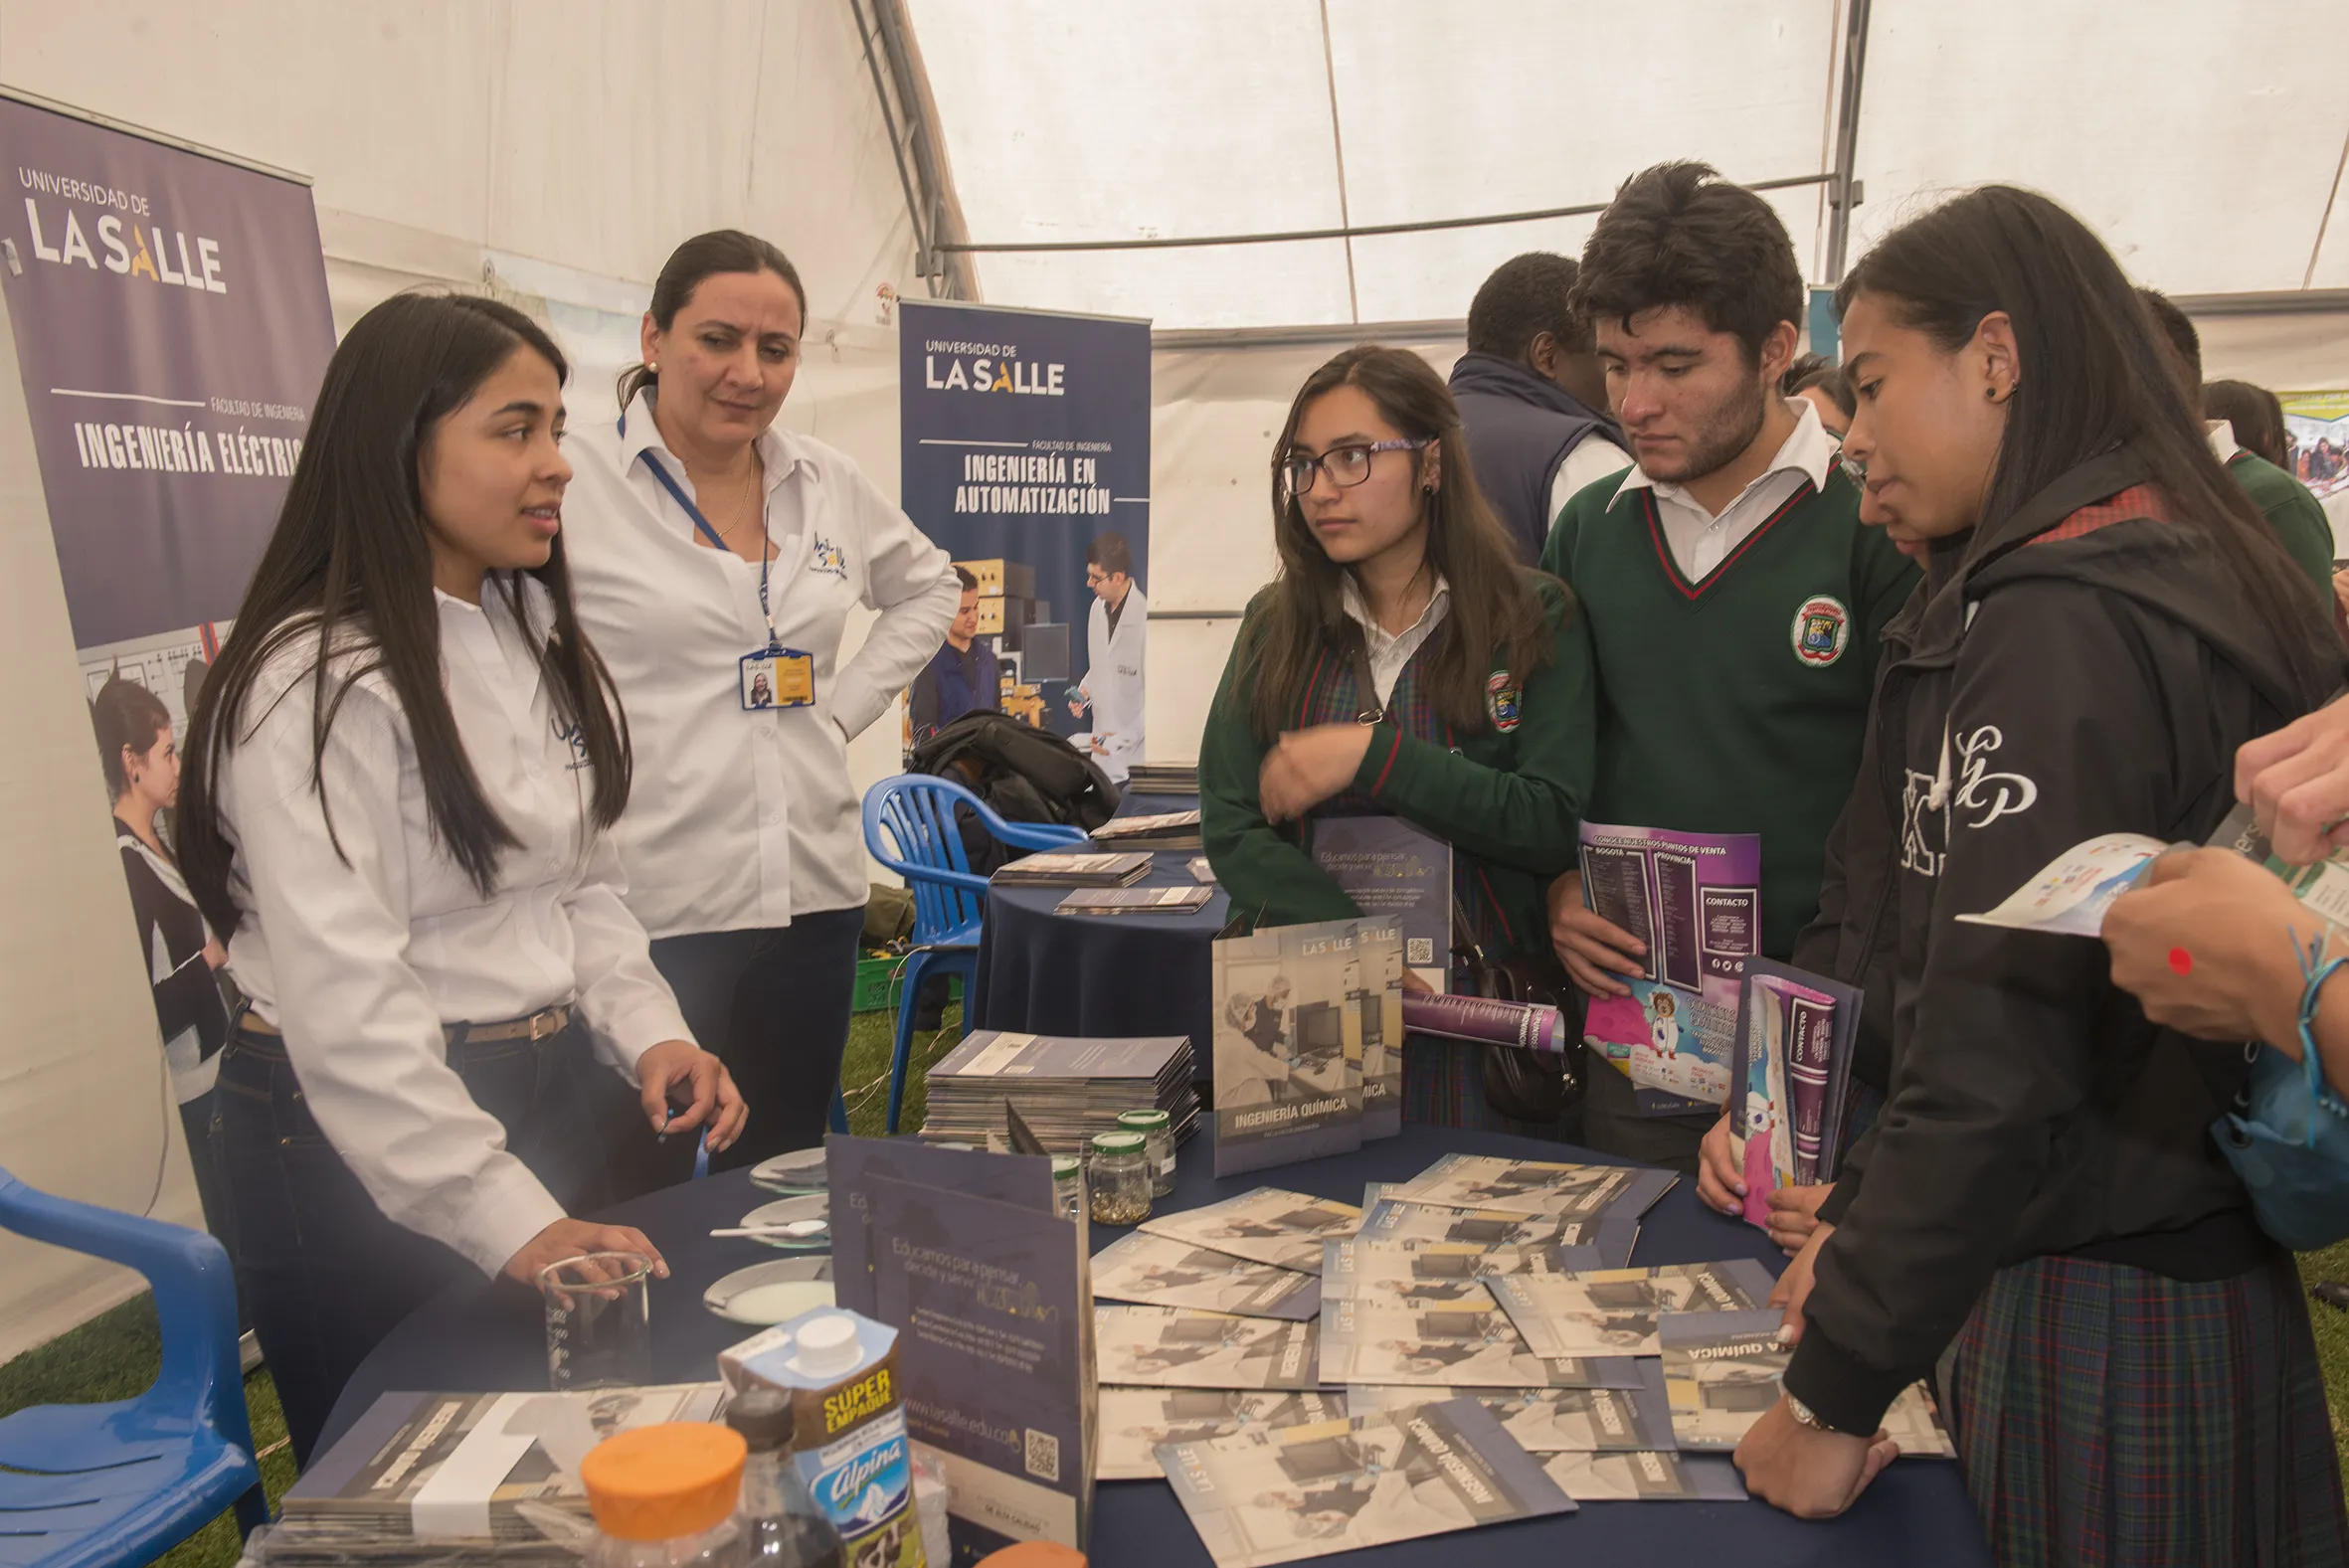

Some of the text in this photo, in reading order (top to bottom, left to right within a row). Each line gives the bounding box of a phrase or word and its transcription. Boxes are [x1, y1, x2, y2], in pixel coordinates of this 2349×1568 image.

[19, 166, 151, 218] UNIVERSIDAD DE
[926, 339, 1017, 358] UNIVERSIDAD DE
[211, 397, 250, 417] FACULTAD
[252, 402, 264, 418] DE
[75, 422, 302, 477] INGENIERÍA ELÉCTRIC
[1065, 440, 1075, 452] DE
[965, 451, 1096, 485] INGENIERÍA EN
[955, 483, 1111, 515] AUTOMATIZACIÓN
[1593, 834, 1726, 856] CONOCE NUESTROS PUNTOS DE VENTA
[1657, 851, 1693, 866] PROVINCIA
[1706, 897, 1749, 908] CONTACTO
[1795, 1010, 1808, 1062] CONTACTO
[1235, 1097, 1348, 1129] INGENIERÍA QUÍMICA
[1689, 1342, 1763, 1359] QUÍMICA
[826, 1393, 893, 1434] EMPAQUE
